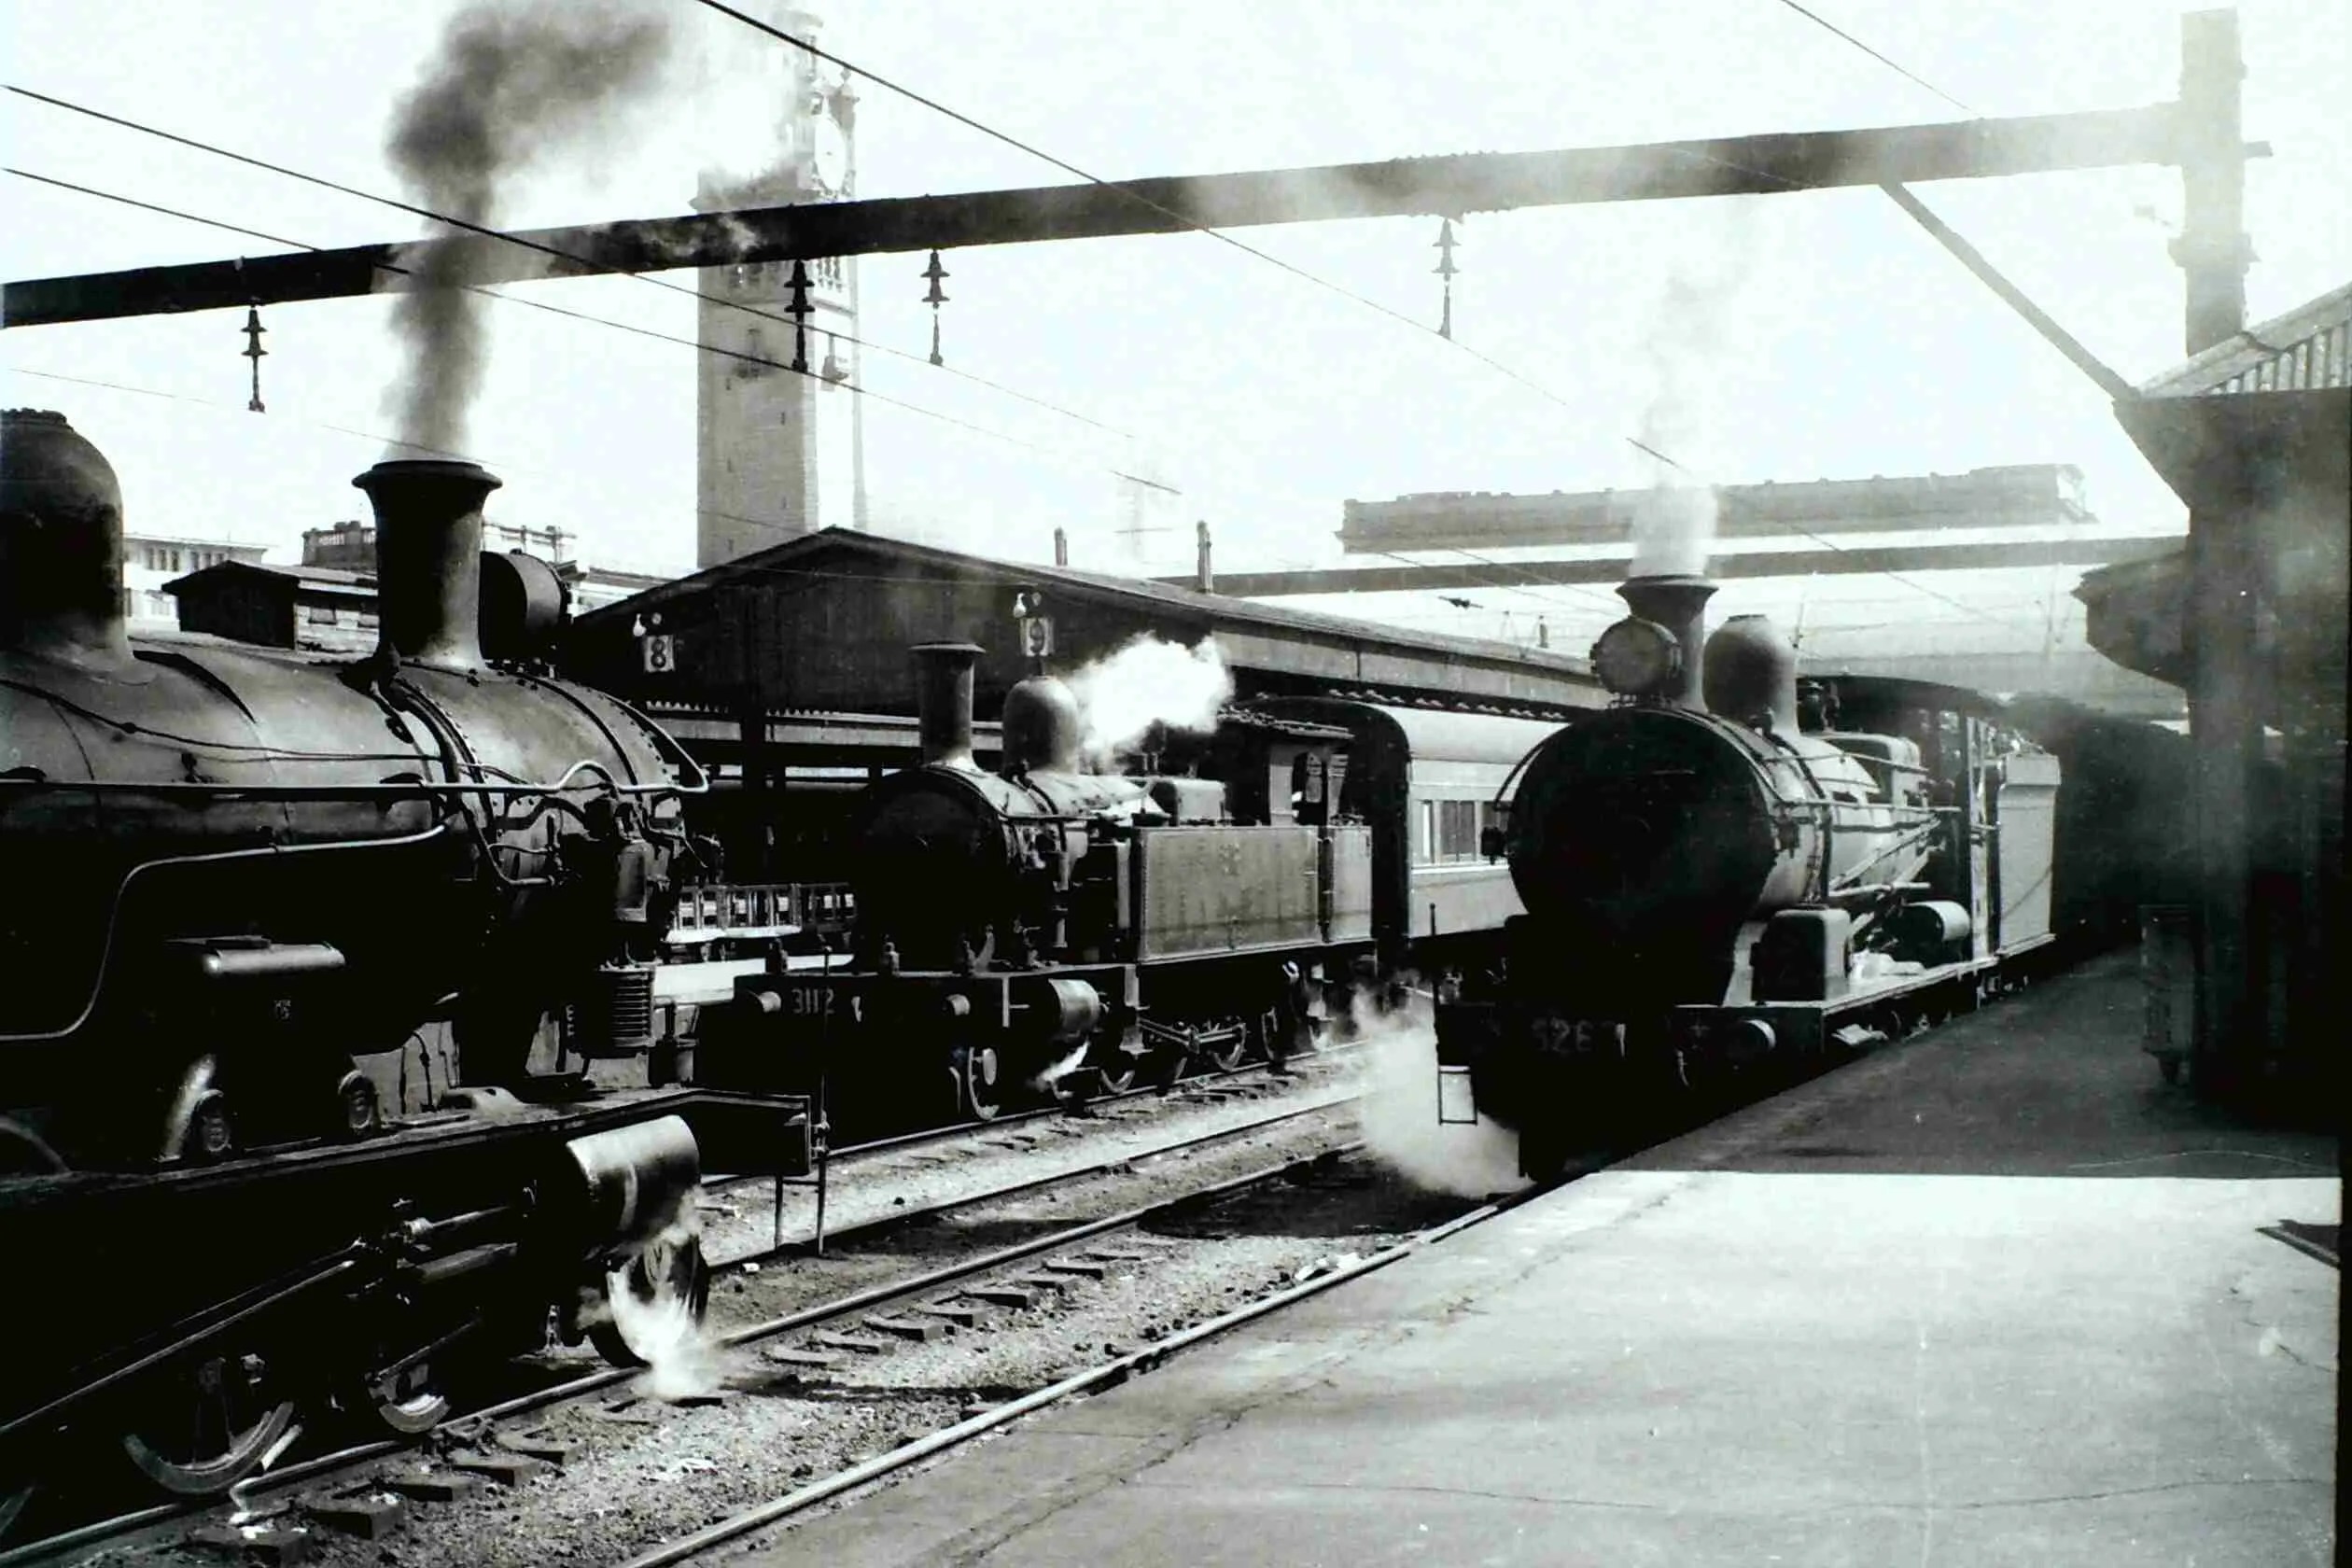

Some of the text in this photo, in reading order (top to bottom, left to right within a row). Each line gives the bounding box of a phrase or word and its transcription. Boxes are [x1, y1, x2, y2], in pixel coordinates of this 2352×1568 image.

[650, 637, 667, 668] 8
[1029, 622, 1045, 653] 9
[791, 987, 836, 1015] 3112
